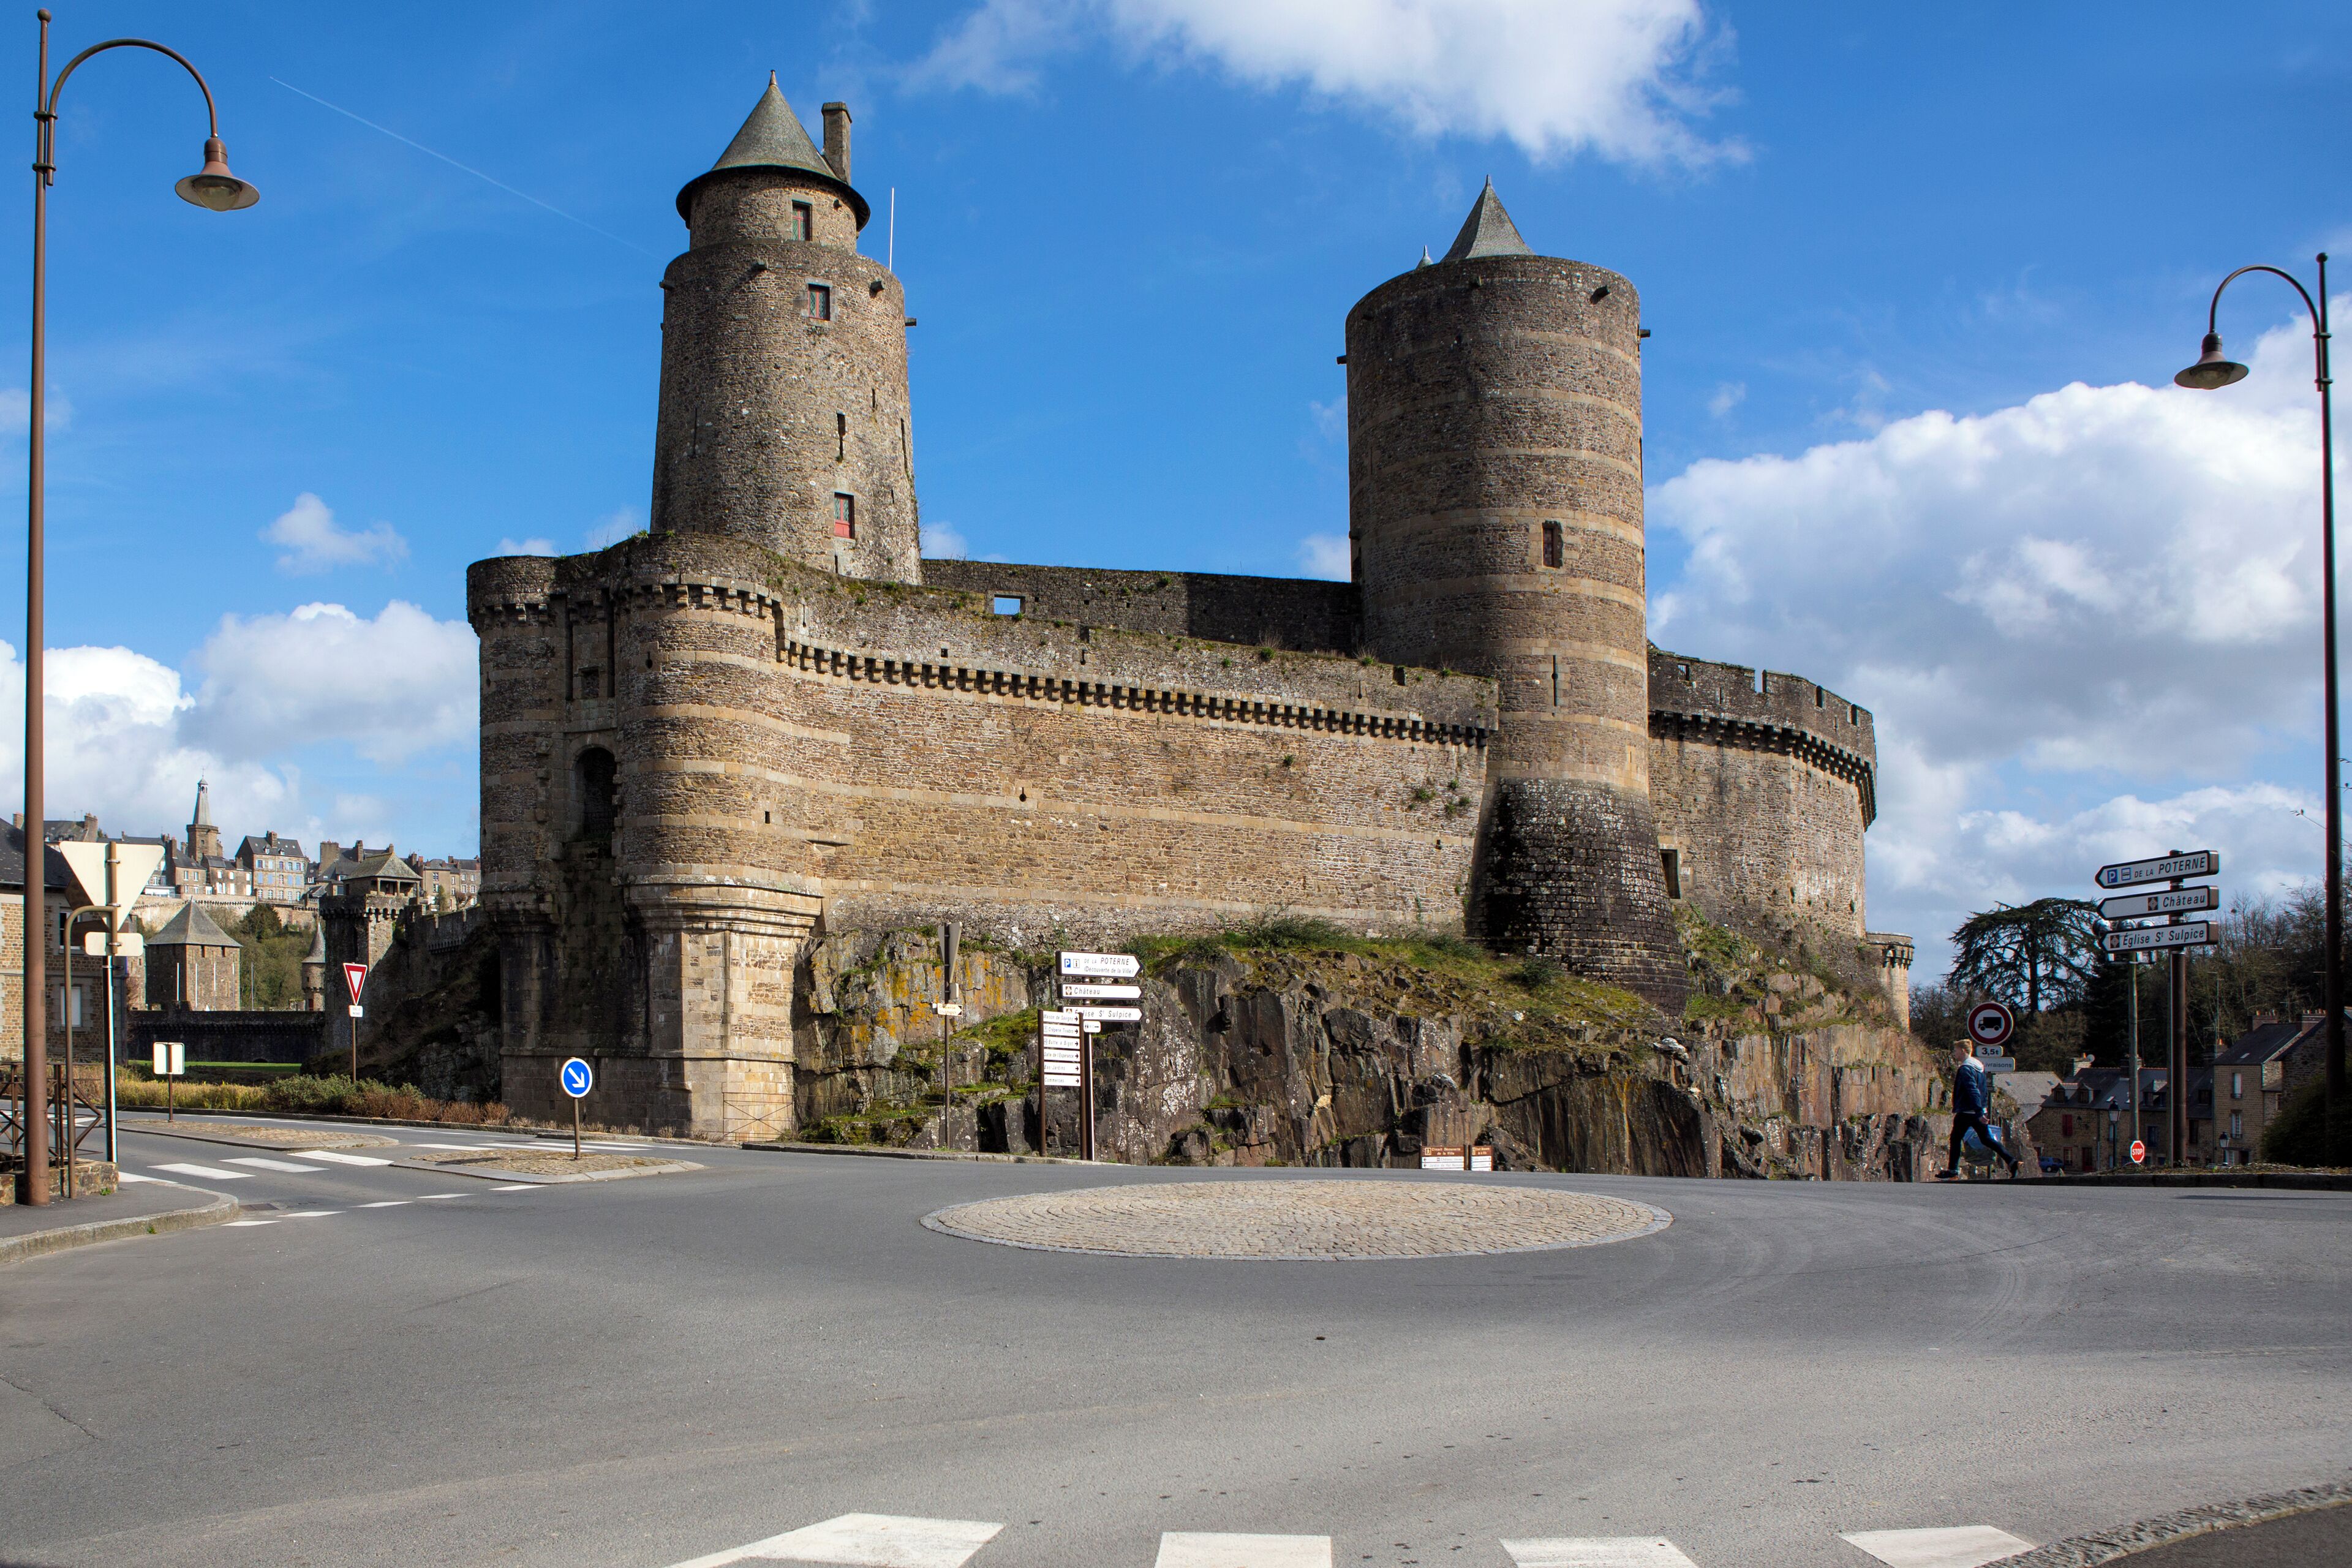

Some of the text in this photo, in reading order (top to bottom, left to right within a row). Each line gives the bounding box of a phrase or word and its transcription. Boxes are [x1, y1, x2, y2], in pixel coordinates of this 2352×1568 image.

[2158, 857, 2206, 874] POTERNE
[2163, 895, 2205, 907] Château
[2123, 929, 2204, 948] Église St Sulpice
[1100, 957, 1129, 965] POTERNE
[1981, 1047, 1999, 1056] 3,5t
